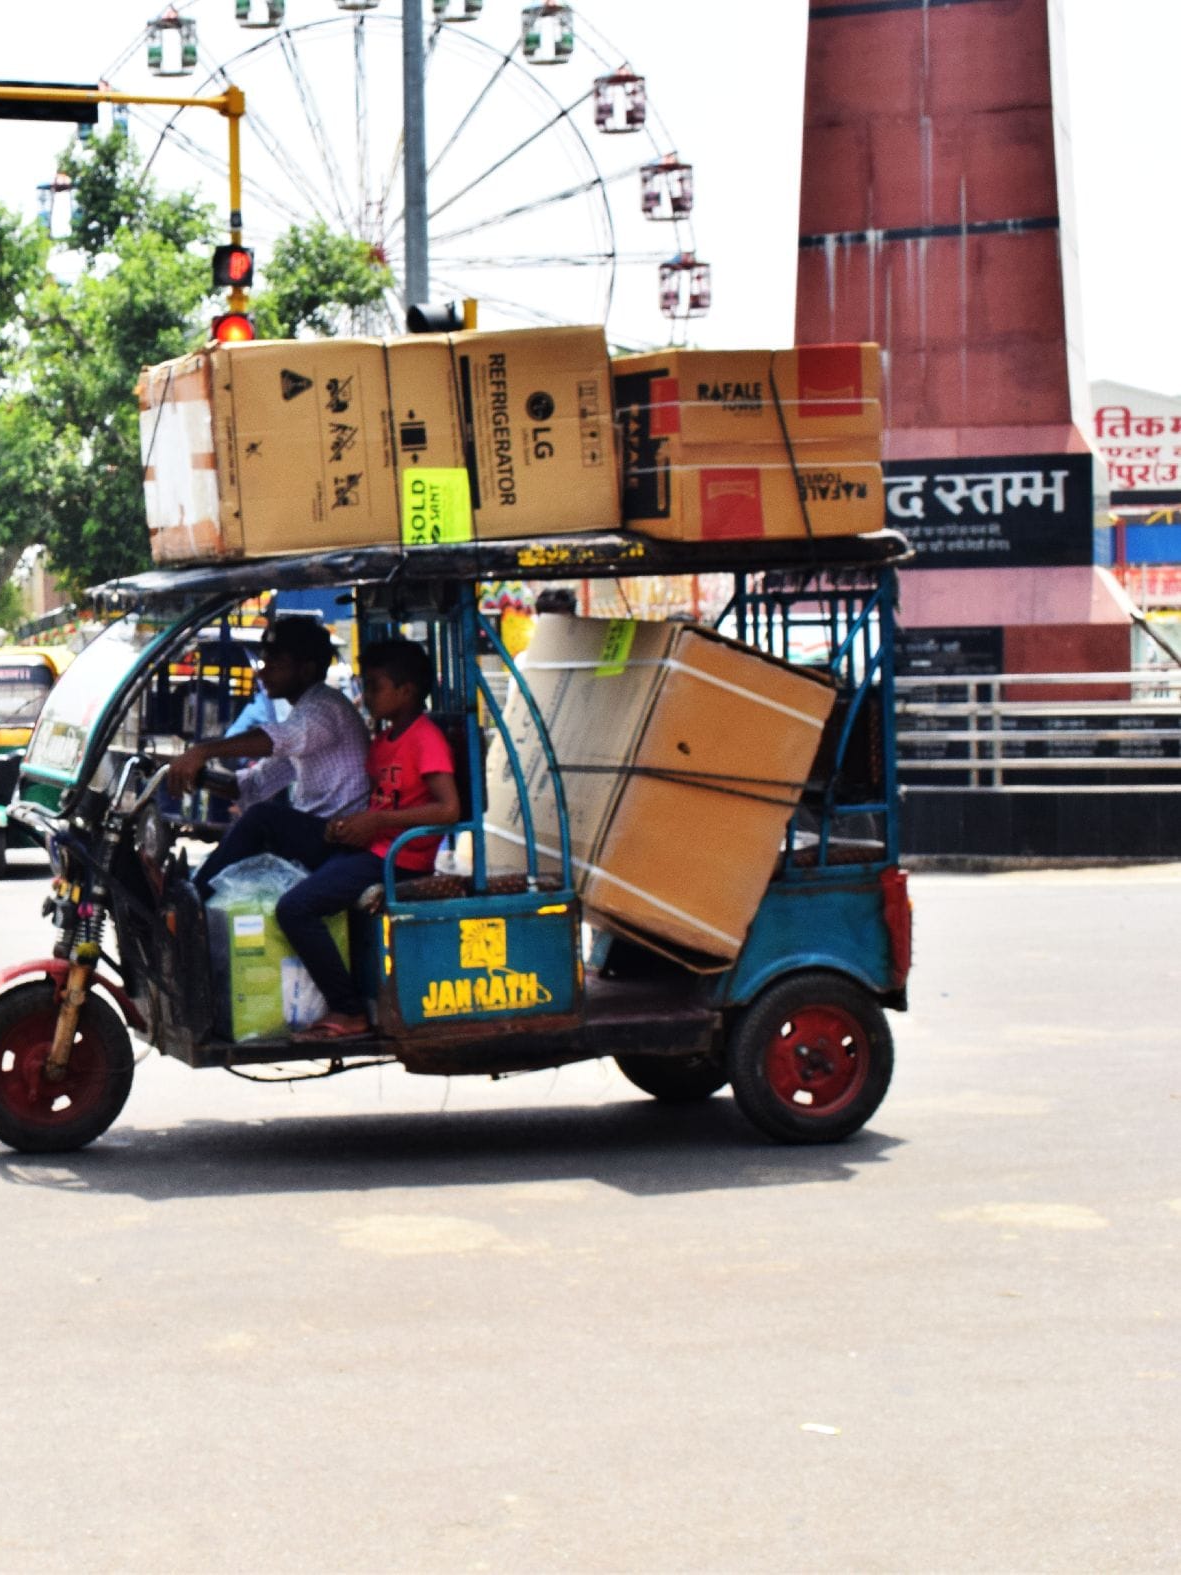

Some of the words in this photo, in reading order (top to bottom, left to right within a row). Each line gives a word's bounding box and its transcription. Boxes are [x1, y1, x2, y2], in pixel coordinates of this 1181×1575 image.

[697, 382, 762, 401] RAFALE
[489, 353, 516, 506] REFRIGERATOR
[532, 427, 554, 460] LG
[934, 470, 1070, 515] स्तम्भ
